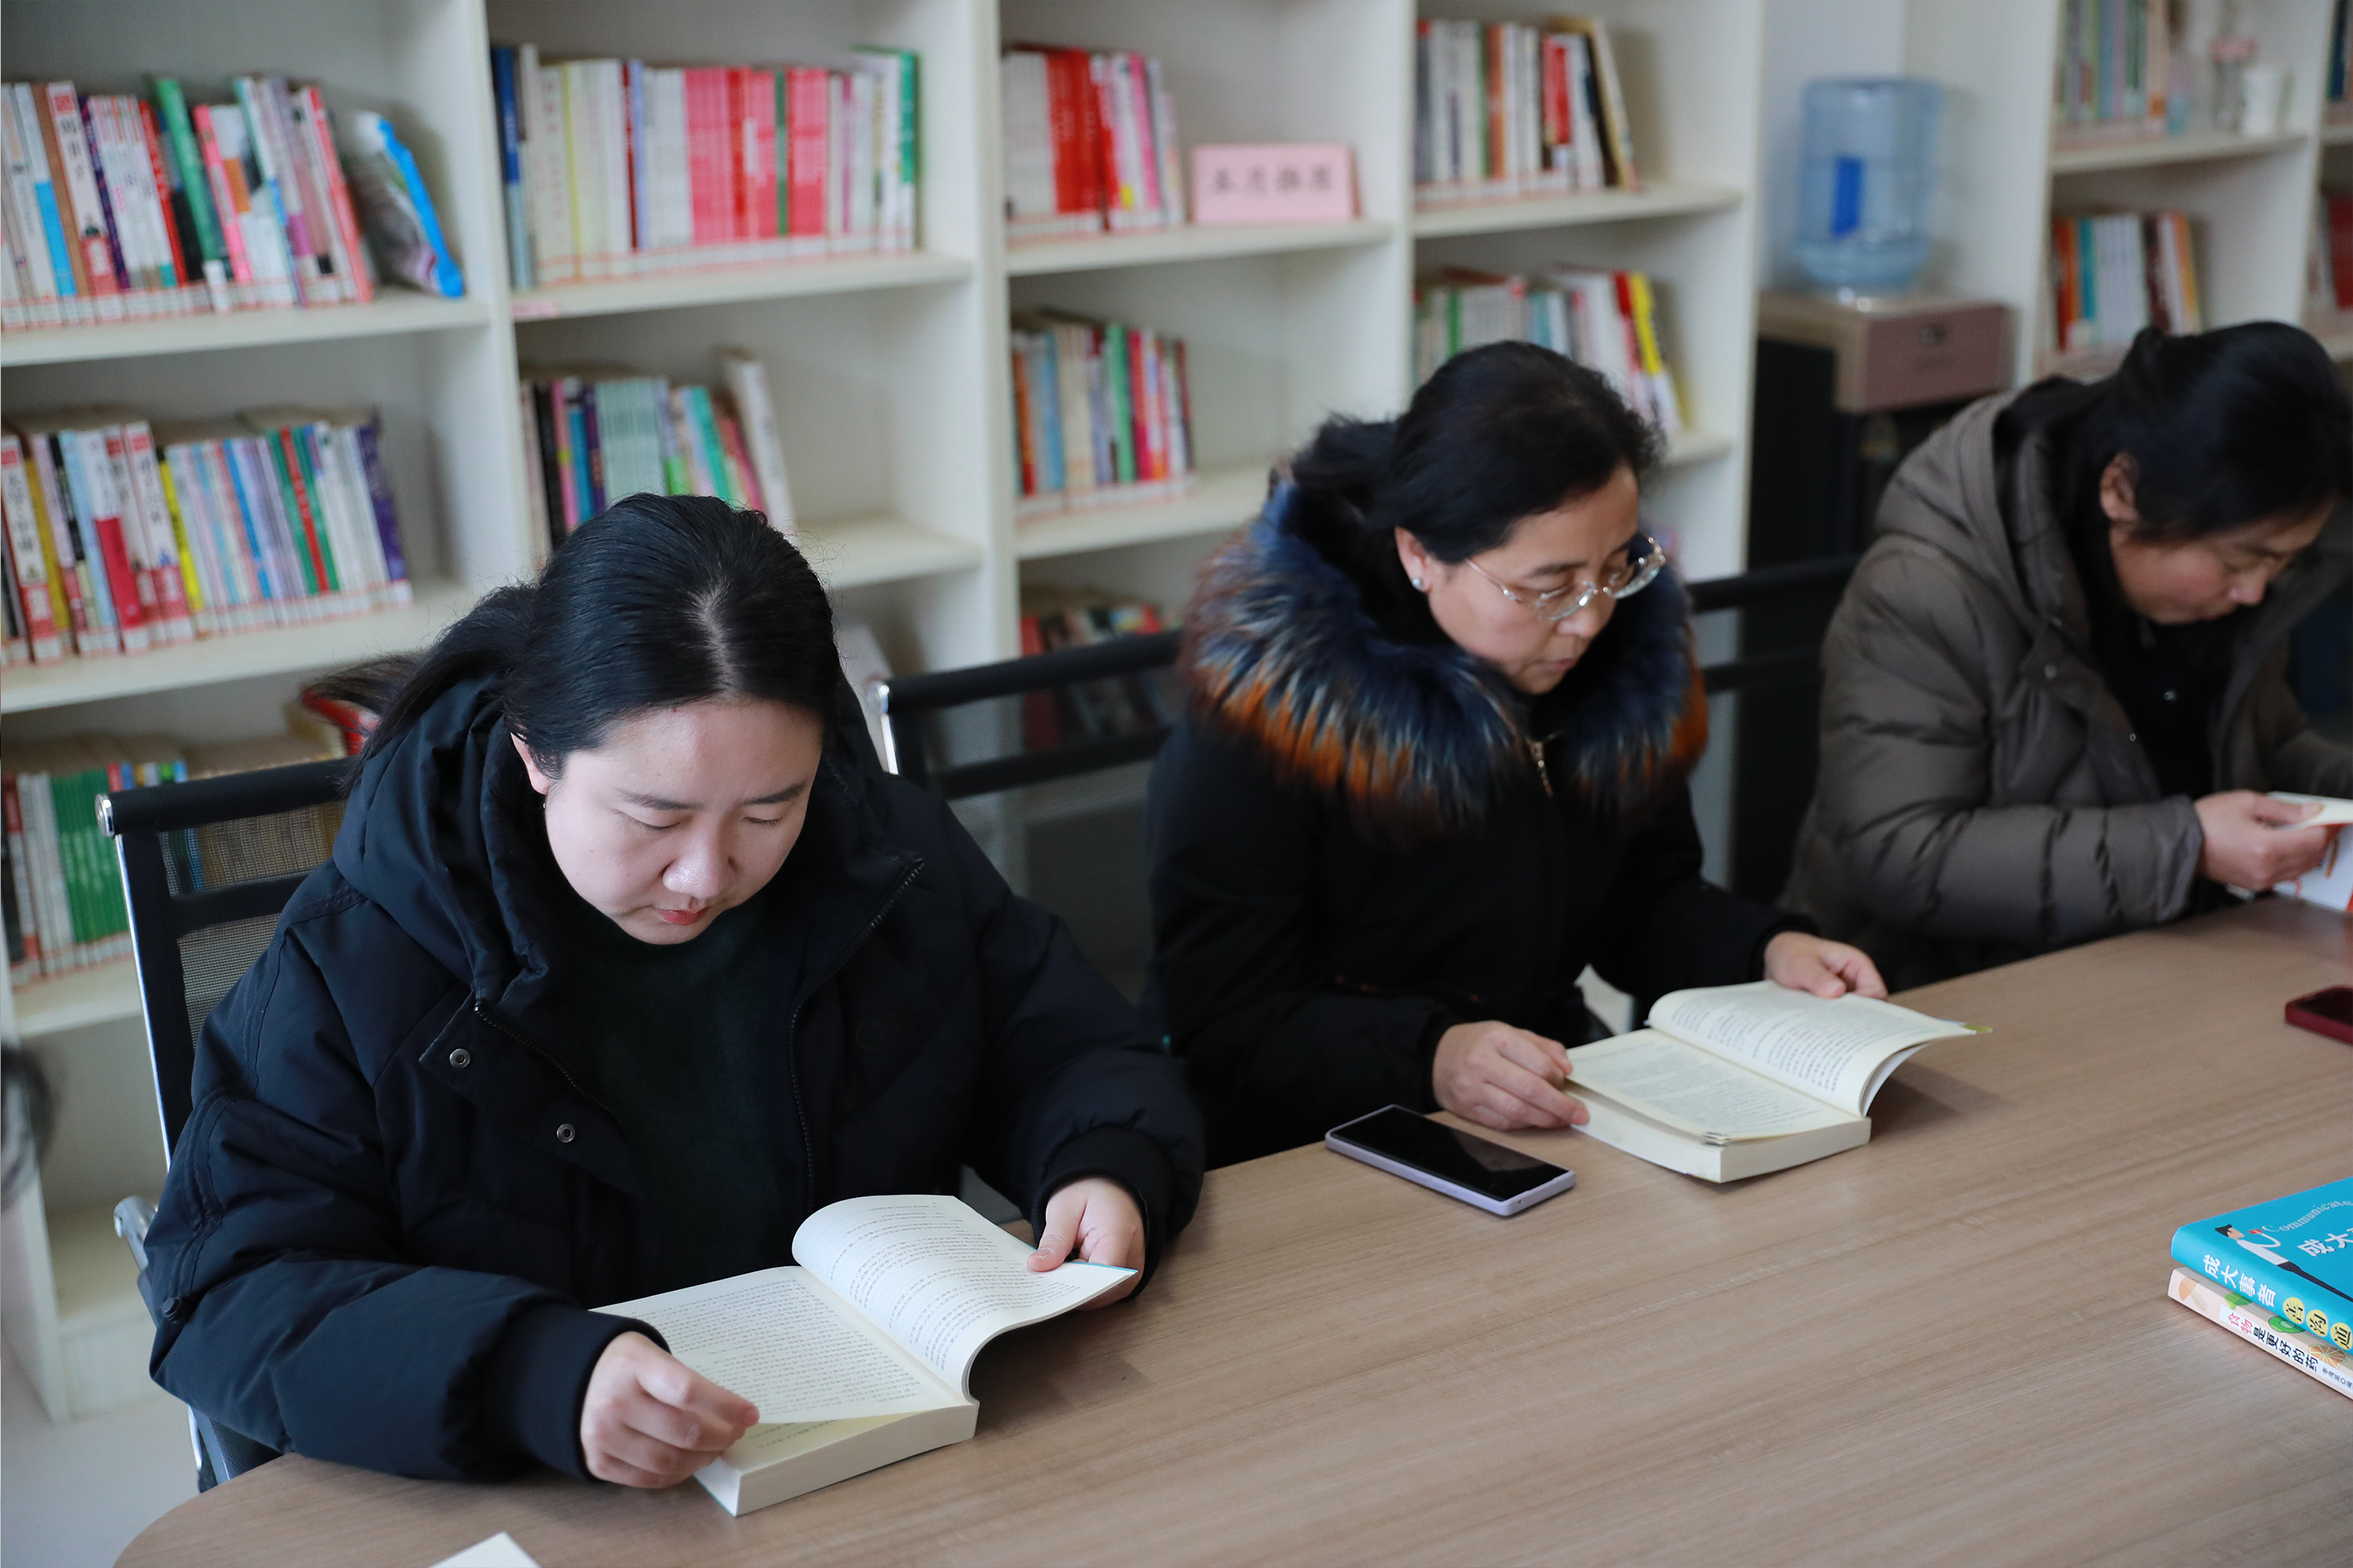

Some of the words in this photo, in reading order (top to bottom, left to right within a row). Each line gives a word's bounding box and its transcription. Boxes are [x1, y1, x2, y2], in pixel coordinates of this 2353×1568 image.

[2297, 1228, 2353, 1257] 成大
[2228, 1312, 2318, 1373] 食物是更好的药
